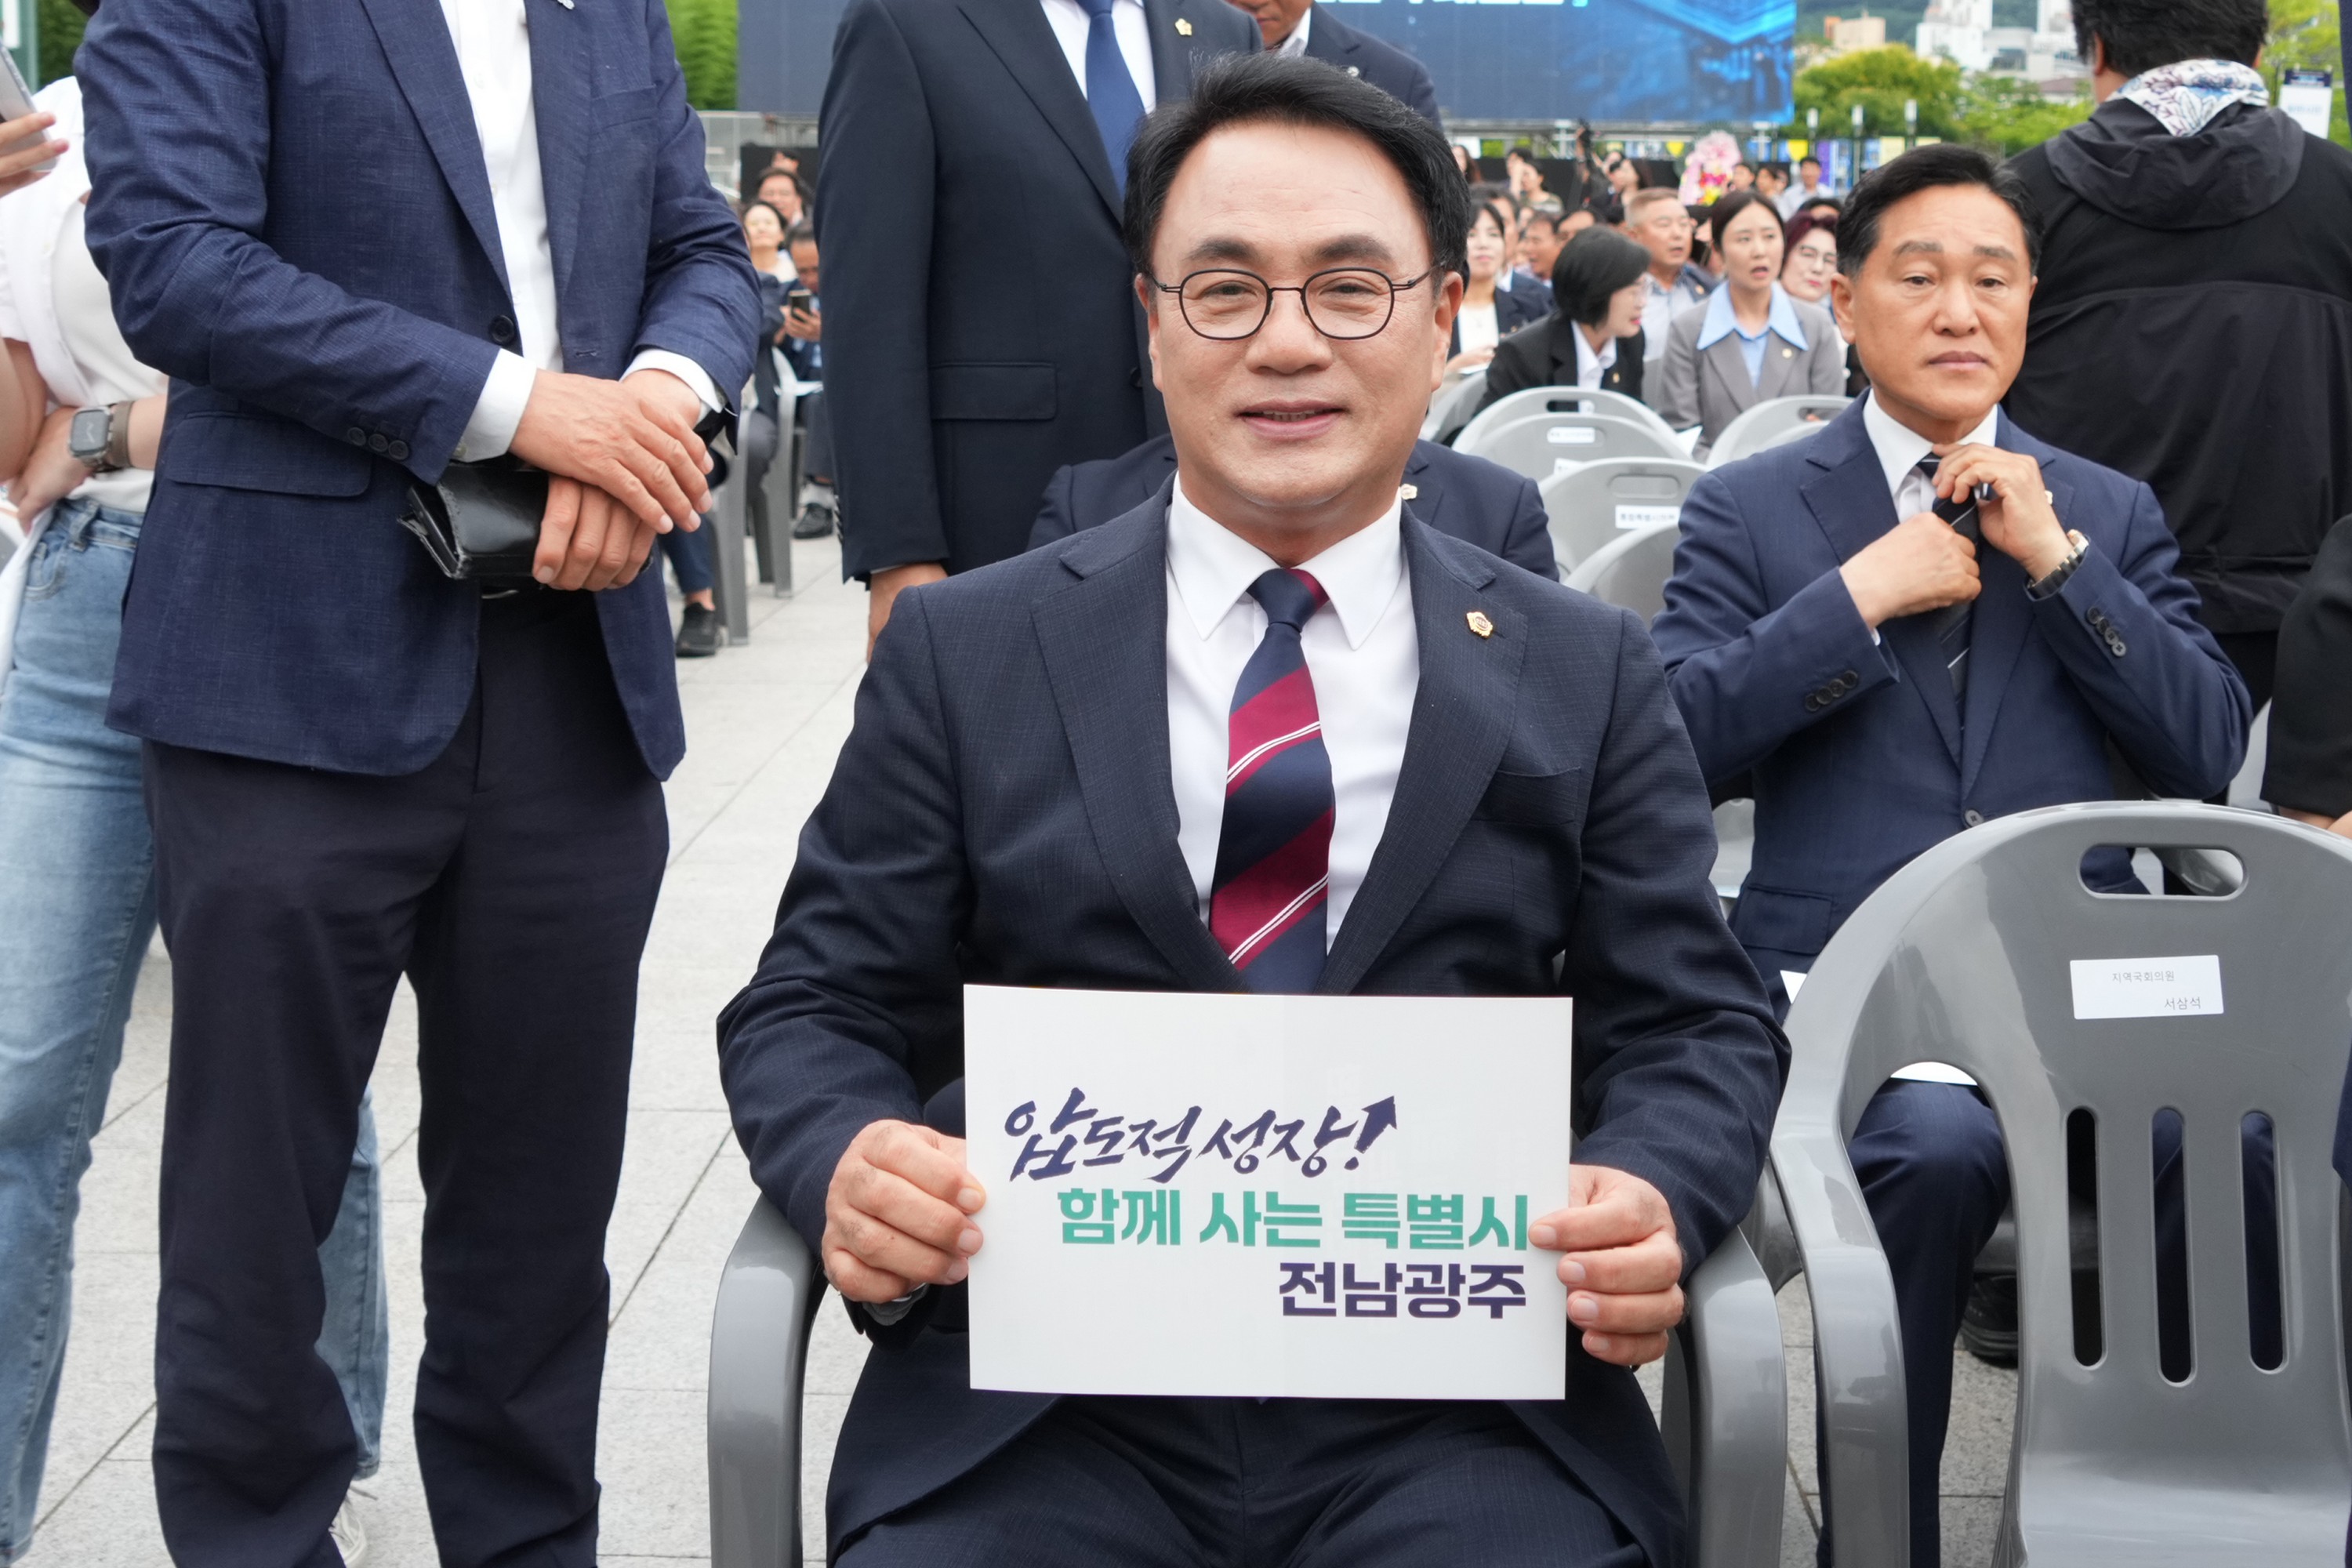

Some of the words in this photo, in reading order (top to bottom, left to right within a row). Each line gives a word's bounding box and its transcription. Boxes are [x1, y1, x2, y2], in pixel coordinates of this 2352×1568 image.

[2112, 970, 2175, 983] 지역국회의원
[2164, 996, 2201, 1011] 서삼석
[1004, 1087, 1202, 1184] 압도적
[1196, 1095, 1398, 1178] 성장!
[1057, 1188, 1181, 1246] 함께
[1200, 1191, 1323, 1248] 사는
[1341, 1192, 1528, 1251] 특별시
[1279, 1261, 1527, 1319] 전남광주
